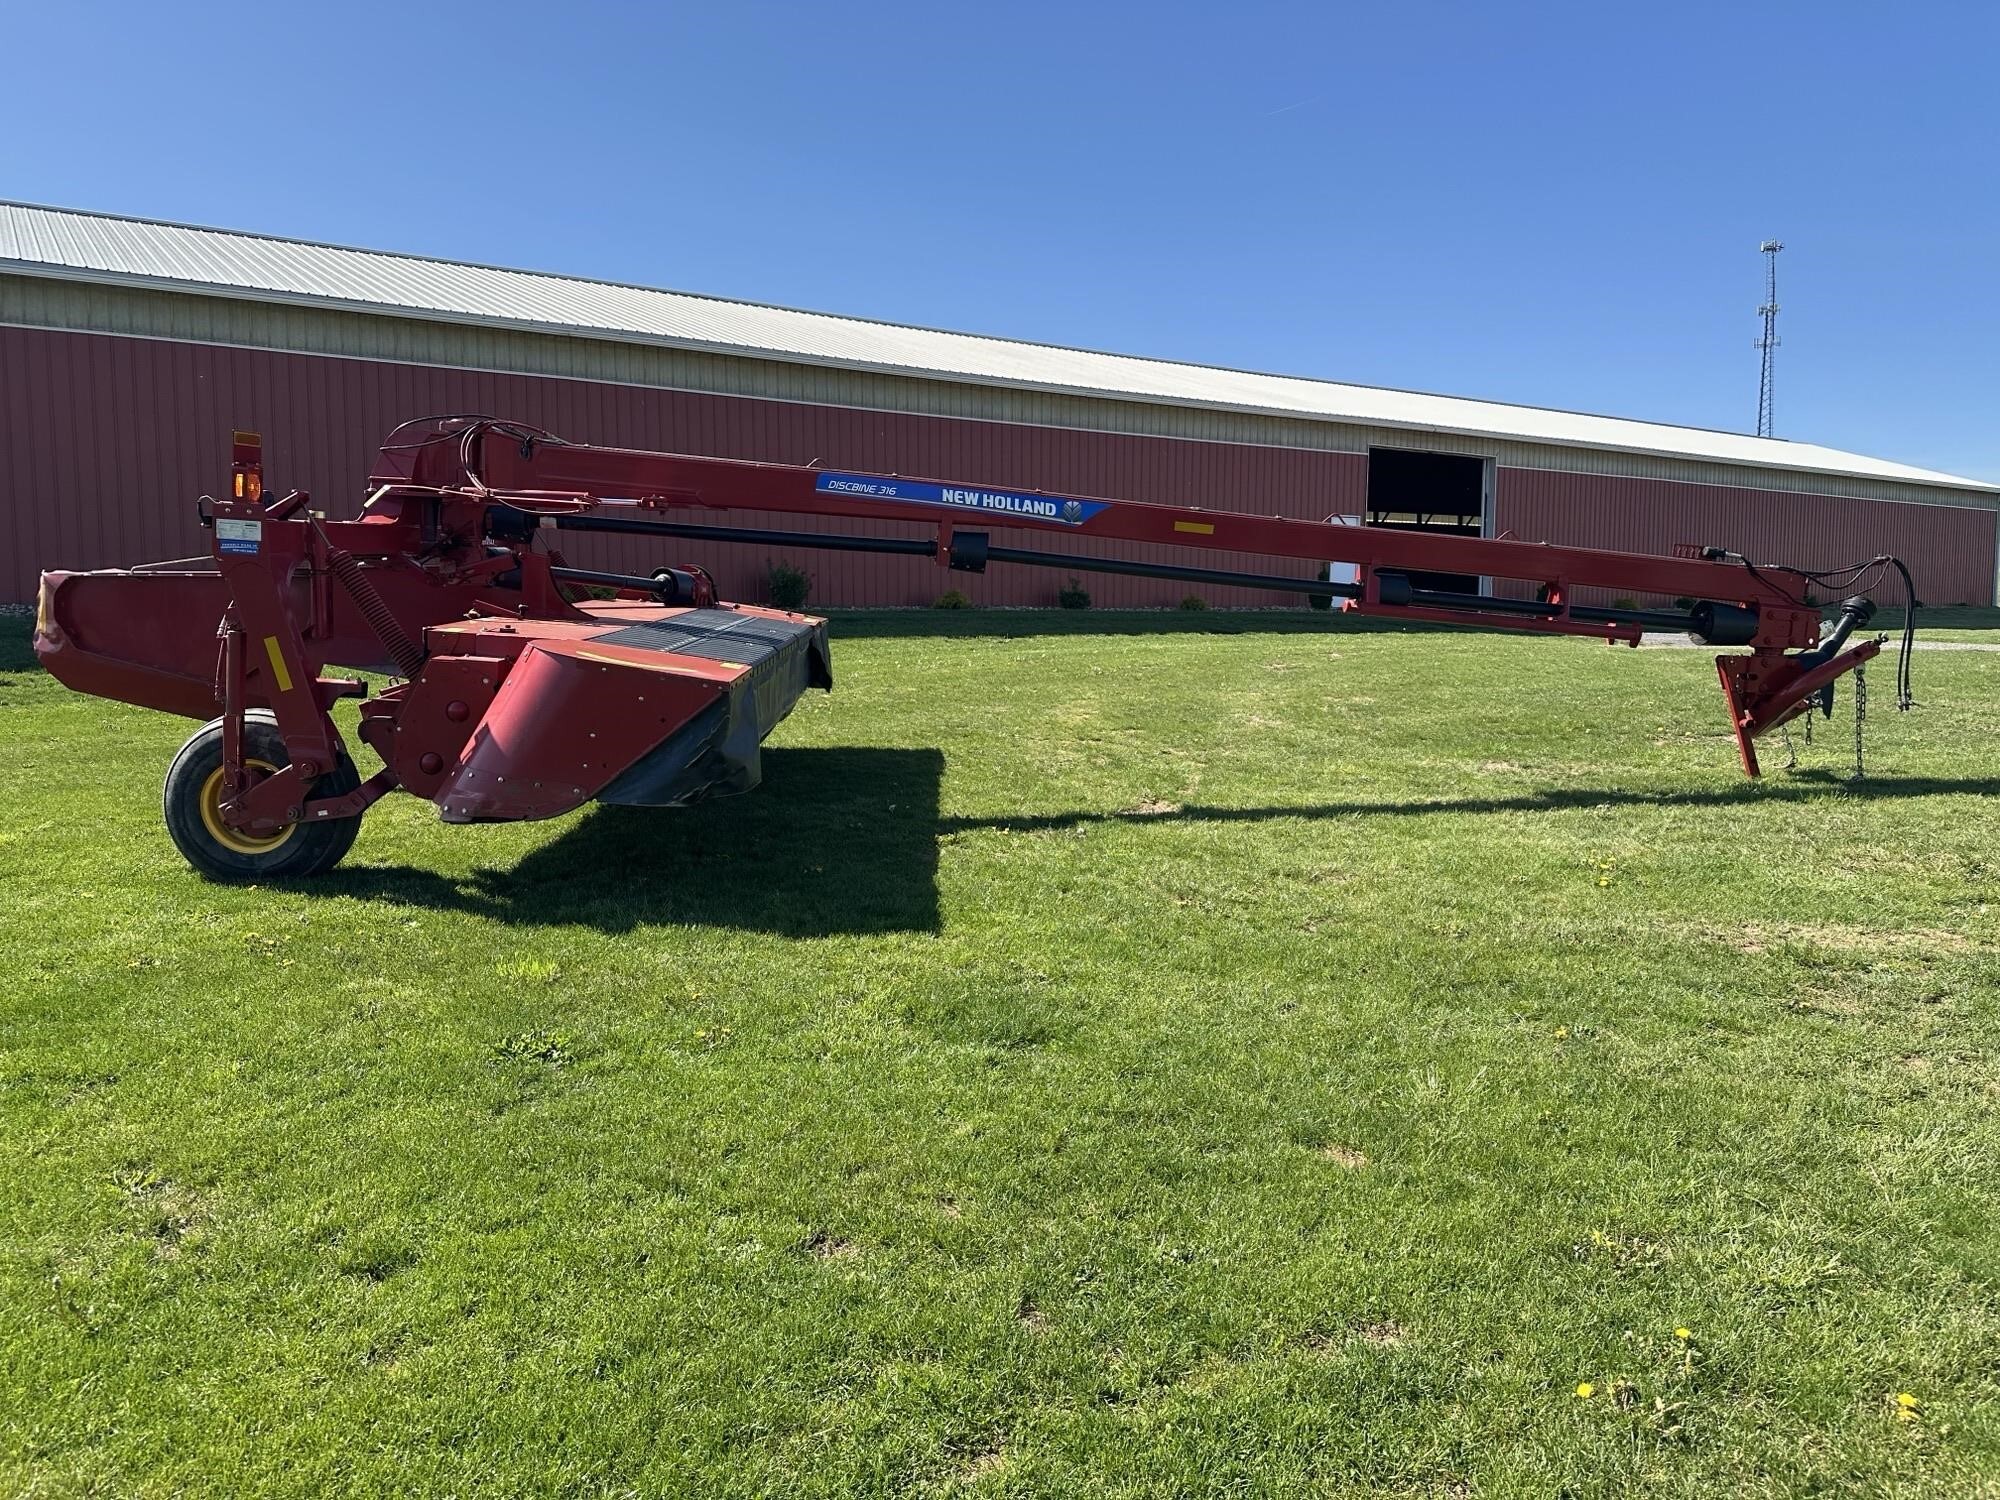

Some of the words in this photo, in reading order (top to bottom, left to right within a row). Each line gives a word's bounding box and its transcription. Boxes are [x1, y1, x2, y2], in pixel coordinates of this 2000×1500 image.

[828, 480, 877, 494] DISCBINE
[878, 485, 897, 495] 316
[942, 488, 979, 506] NEW
[982, 493, 1057, 516] HOLLAND
